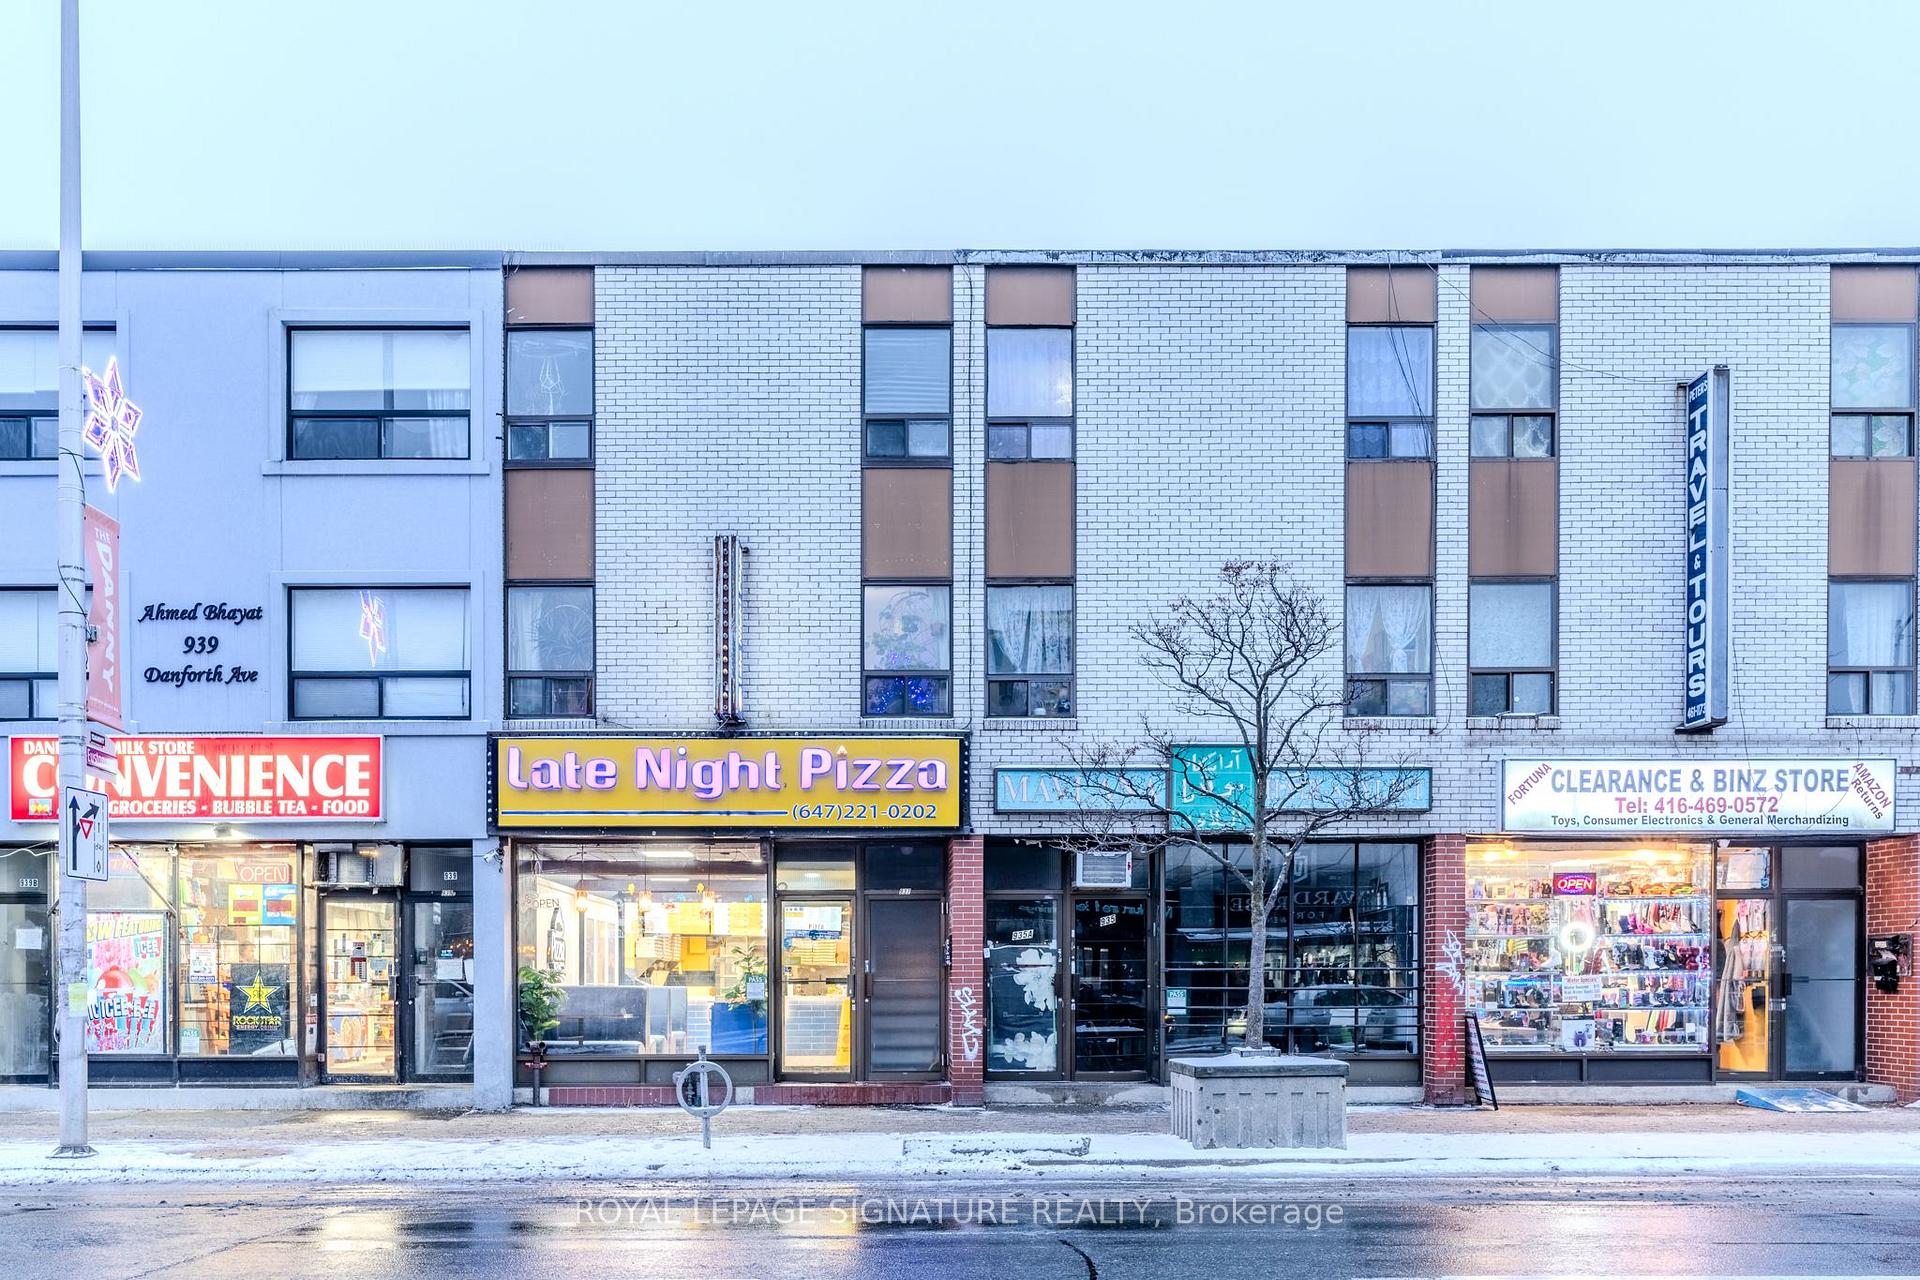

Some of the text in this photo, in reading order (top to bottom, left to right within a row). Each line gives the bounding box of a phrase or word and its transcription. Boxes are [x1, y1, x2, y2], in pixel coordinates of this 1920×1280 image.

[1688, 404, 1706, 553] TRAVEL
[94, 527, 111, 545] THE
[95, 539, 114, 695] DANNY
[138, 603, 263, 625] Ahmed Bhayat
[182, 635, 218, 654] 939
[1688, 573, 1706, 698] TOURS
[144, 665, 258, 688] Danforth Ave
[148, 741, 195, 755] STORE
[22, 754, 370, 798] CNVENIENCE
[506, 744, 947, 800] Late Night Pizza
[1550, 768, 1850, 794] CLEARANCE & BINZ STORE
[1508, 762, 1553, 806] FORTUNA
[1851, 761, 1891, 810] AMAZON
[109, 800, 196, 815] GROCERIES
[212, 800, 275, 815] BUBBLE
[278, 800, 307, 815] TEA
[322, 800, 370, 815] FOOD
[1614, 795, 1779, 815] Tel: 416-469-0572
[1851, 778, 1884, 820] Returns
[791, 803, 937, 821] (647)221-0202
[1551, 814, 1850, 829] Toys, Consumer Electronics & General Merchandizing
[240, 866, 287, 882] OPEN
[1558, 879, 1593, 890] OPEN
[531, 898, 560, 909] OPEN
[1100, 914, 1116, 927] 935
[1012, 929, 1034, 941] 935A
[233, 1015, 282, 1026] ROCKSTAR
